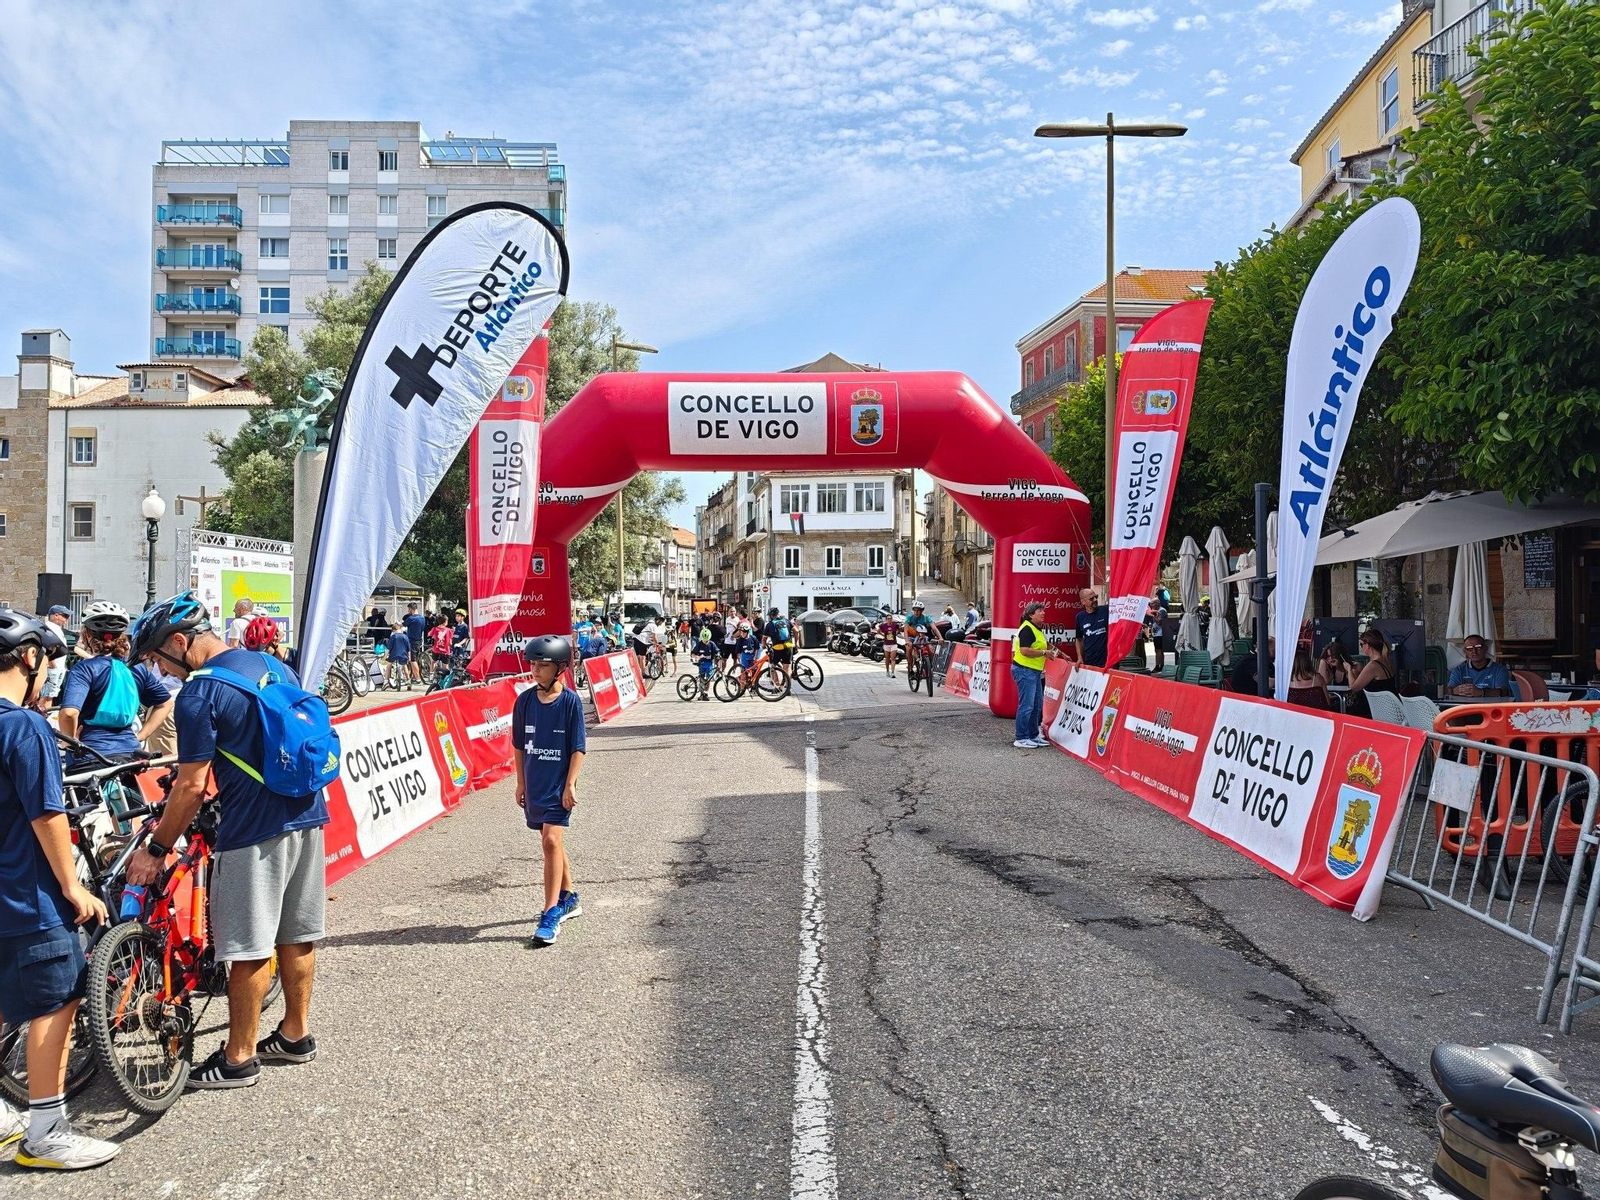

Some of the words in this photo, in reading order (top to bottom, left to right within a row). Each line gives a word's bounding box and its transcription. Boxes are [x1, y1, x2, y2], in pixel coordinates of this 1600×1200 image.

[433, 240, 527, 370] DEPORTE
[472, 261, 543, 353] Atlántico
[1157, 339, 1177, 347] VIGO,
[680, 395, 814, 414] CONCELLO
[1289, 265, 1391, 538] Atlántico
[697, 420, 729, 439] DE
[738, 420, 799, 439] VIGO
[508, 441, 524, 489] VIGO
[1145, 452, 1163, 498] VIGO
[492, 430, 508, 536] CONCELLO
[538, 482, 558, 496] GO,
[1008, 478, 1041, 491] VIGO,
[1124, 441, 1146, 540] CONCELLO
[506, 492, 520, 523] DE
[556, 494, 584, 506] xogo
[981, 490, 1016, 501] terreo
[1021, 490, 1034, 501] de
[1039, 492, 1064, 504] xogo
[1139, 503, 1153, 527] DE
[1016, 549, 1067, 558] CONCELLO
[1021, 558, 1034, 567] DE
[1037, 558, 1061, 567] VIGO
[1022, 584, 1059, 595] Vivimos
[507, 642, 520, 655] de
[1154, 707, 1173, 732] VIGO,
[1134, 723, 1155, 744] terreo
[1155, 730, 1166, 748] de
[1164, 735, 1184, 758] xogo
[346, 730, 422, 783] CONCELLO
[1213, 725, 1314, 786] CONCELLO
[368, 784, 391, 821] DE
[390, 769, 428, 808] VIGO
[1156, 782, 1170, 794] CIDADE
[1170, 788, 1179, 798] PARA
[1179, 792, 1190, 804] VIVIR
[1211, 768, 1236, 805] DE
[1241, 777, 1289, 829] VIGO
[325, 852, 339, 866] PARA
[338, 844, 354, 858] VIVIR
